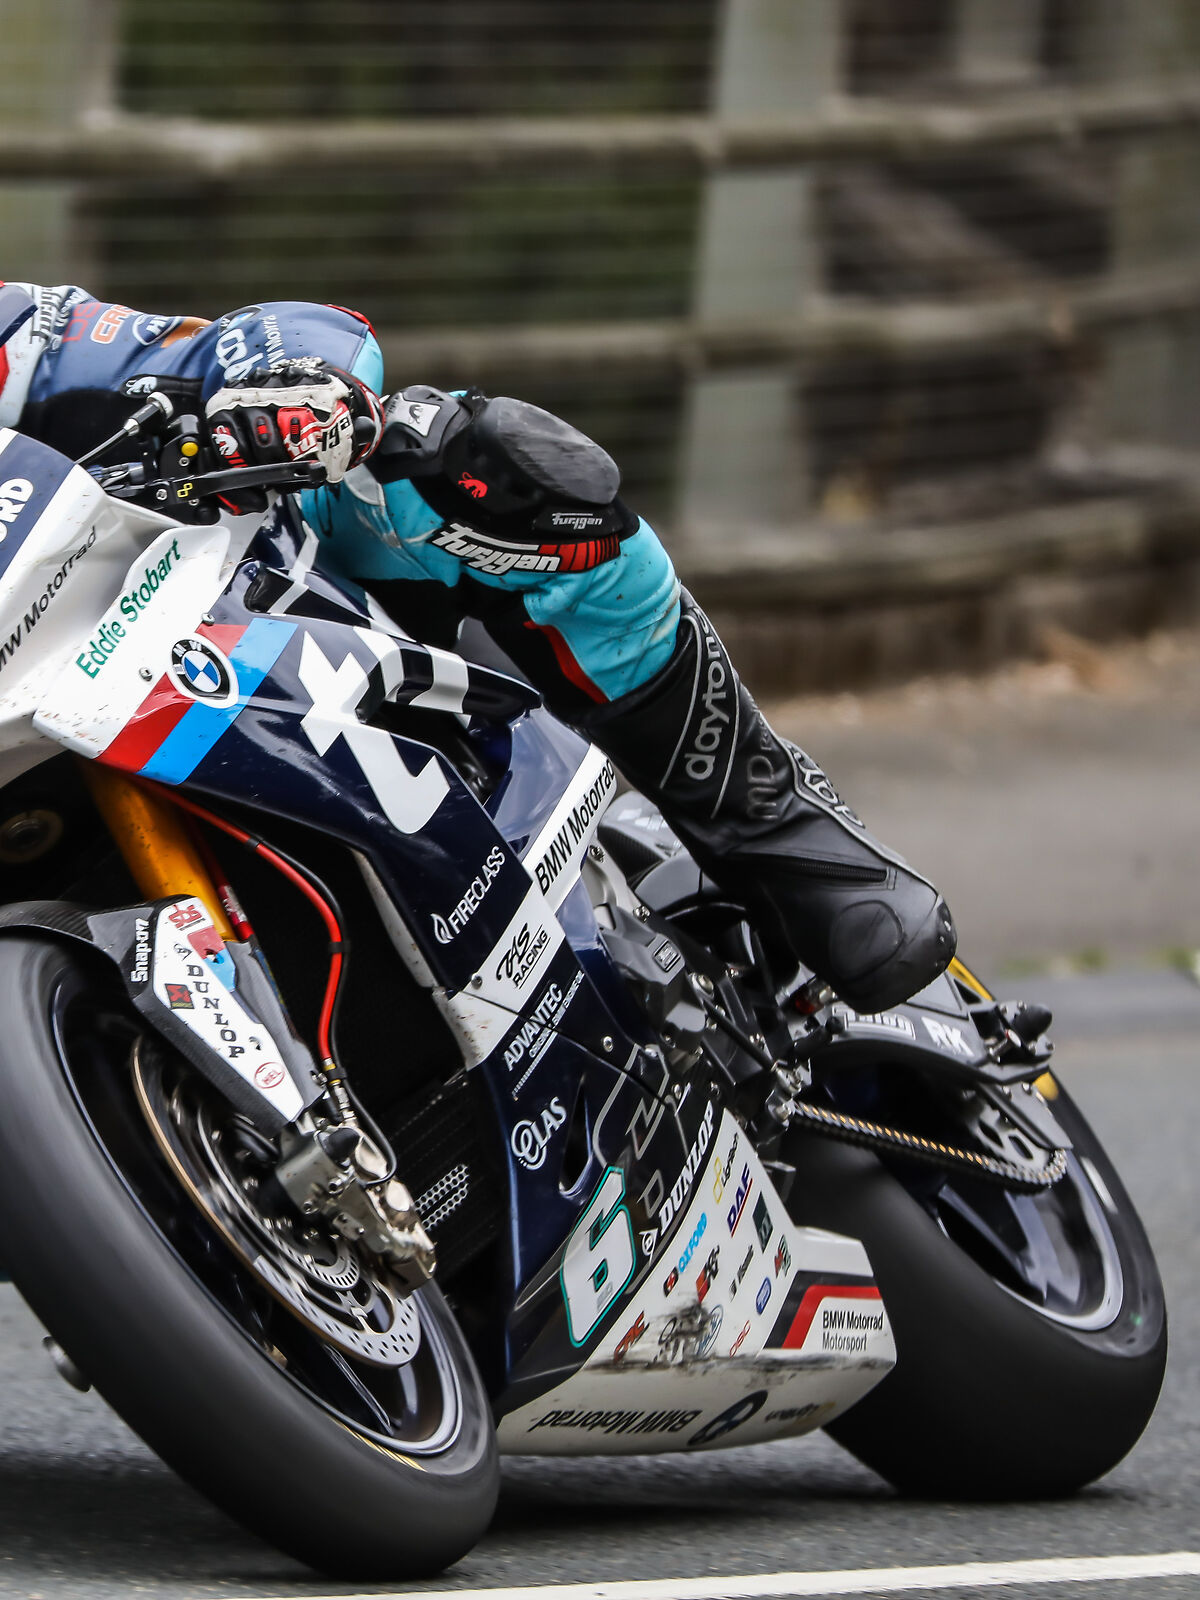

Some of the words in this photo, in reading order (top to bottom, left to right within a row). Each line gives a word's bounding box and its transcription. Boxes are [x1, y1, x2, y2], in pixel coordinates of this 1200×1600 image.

[432, 522, 561, 575] Furygan
[552, 512, 602, 530] Furygan
[25, 525, 97, 633] Motorrad
[75, 619, 126, 679] Eddie
[119, 538, 181, 622] Stobart
[448, 846, 506, 935] FIRECLASS
[534, 841, 569, 896] BMW
[513, 931, 548, 987] RACING
[187, 964, 245, 1060] DUNLOP
[502, 984, 563, 1072] ADVANTEC
[921, 1016, 974, 1056] RK
[658, 1100, 714, 1236] DUNLOP
[727, 1162, 750, 1233] DAF
[560, 1167, 636, 1348] 6
[678, 1212, 707, 1273] OXFORD
[822, 1310, 846, 1328] BMW
[847, 1311, 883, 1331] Motorrad
[822, 1335, 867, 1352] Motorsport
[528, 1409, 646, 1434] Motorrad
[633, 1409, 703, 1433] BMW
